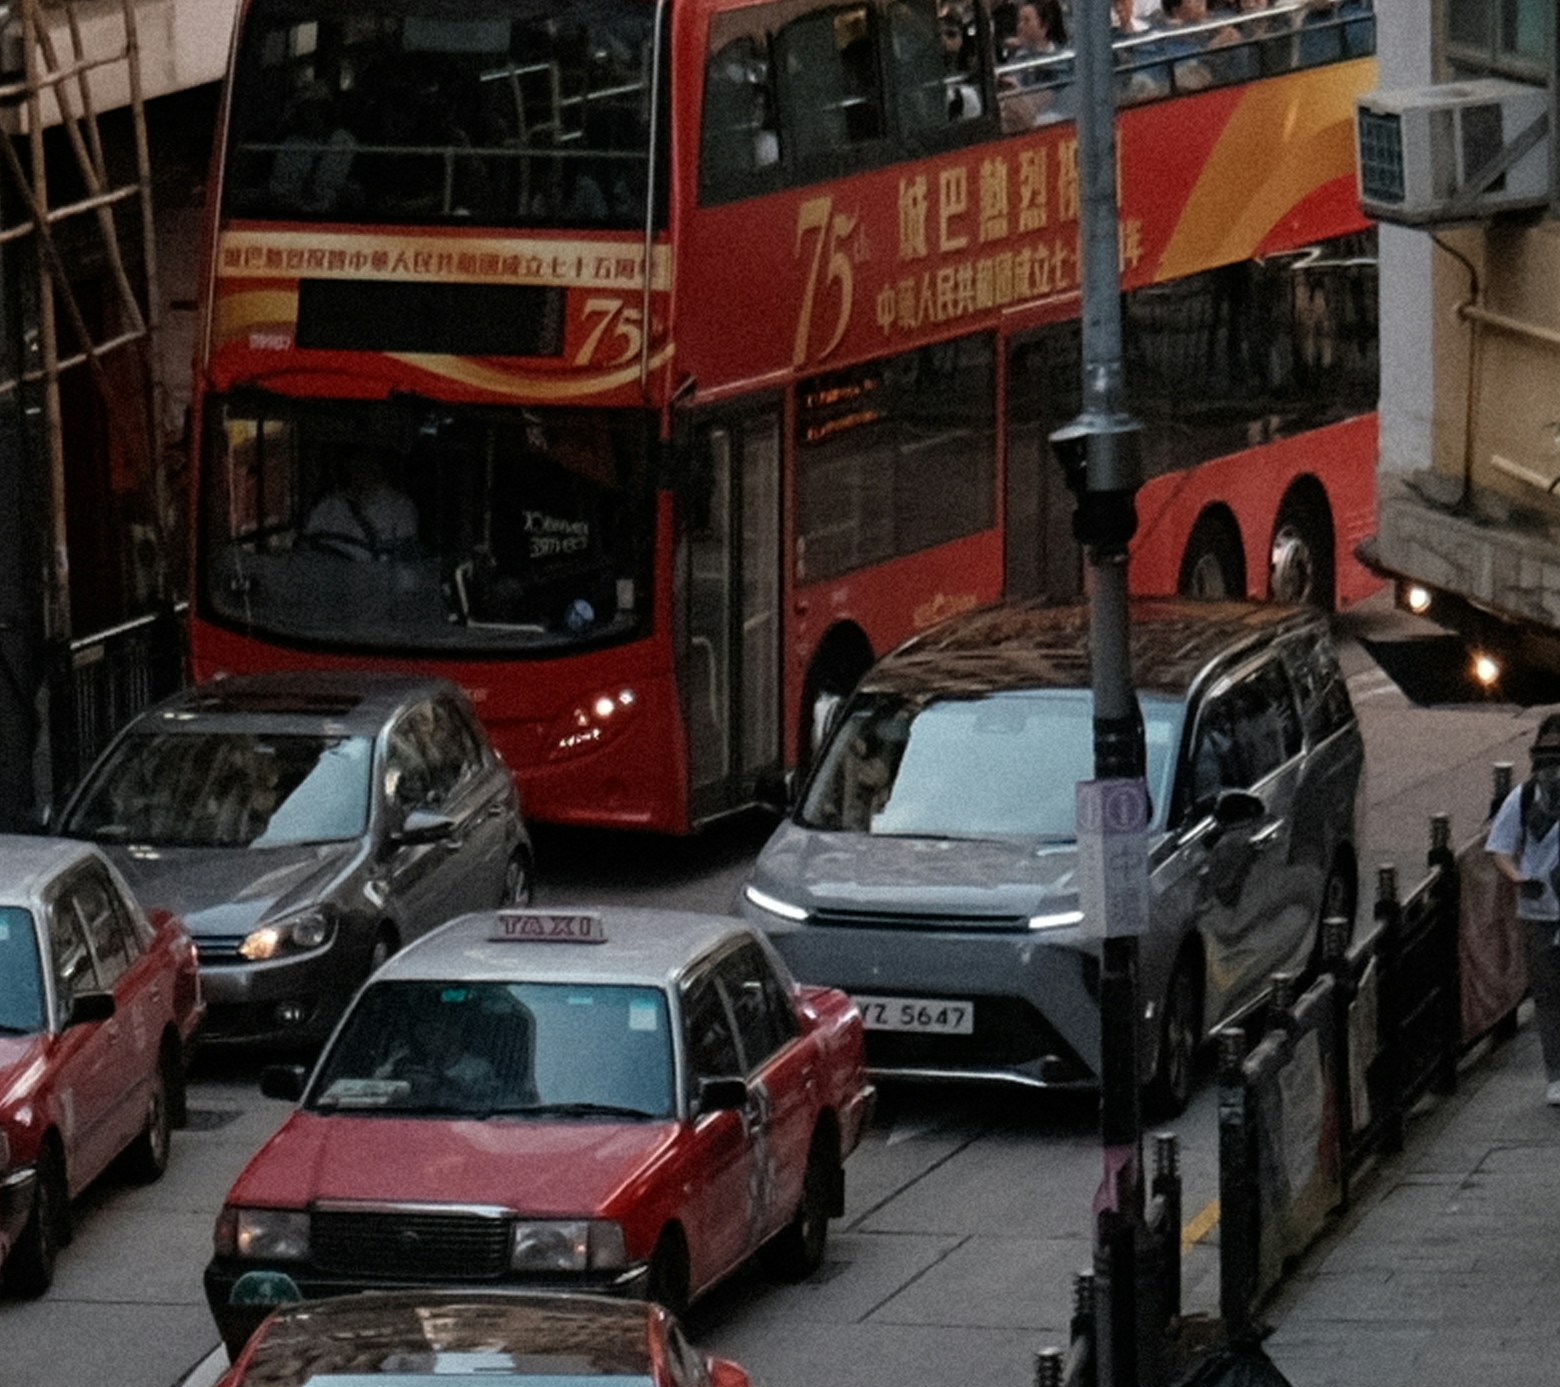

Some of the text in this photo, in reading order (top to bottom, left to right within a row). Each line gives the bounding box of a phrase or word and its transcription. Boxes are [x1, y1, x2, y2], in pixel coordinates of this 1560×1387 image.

[899, 137, 1122, 261] 城巴熱烈祝
[500, 916, 592, 937] TAXI
[900, 1005, 967, 1029] 5647
